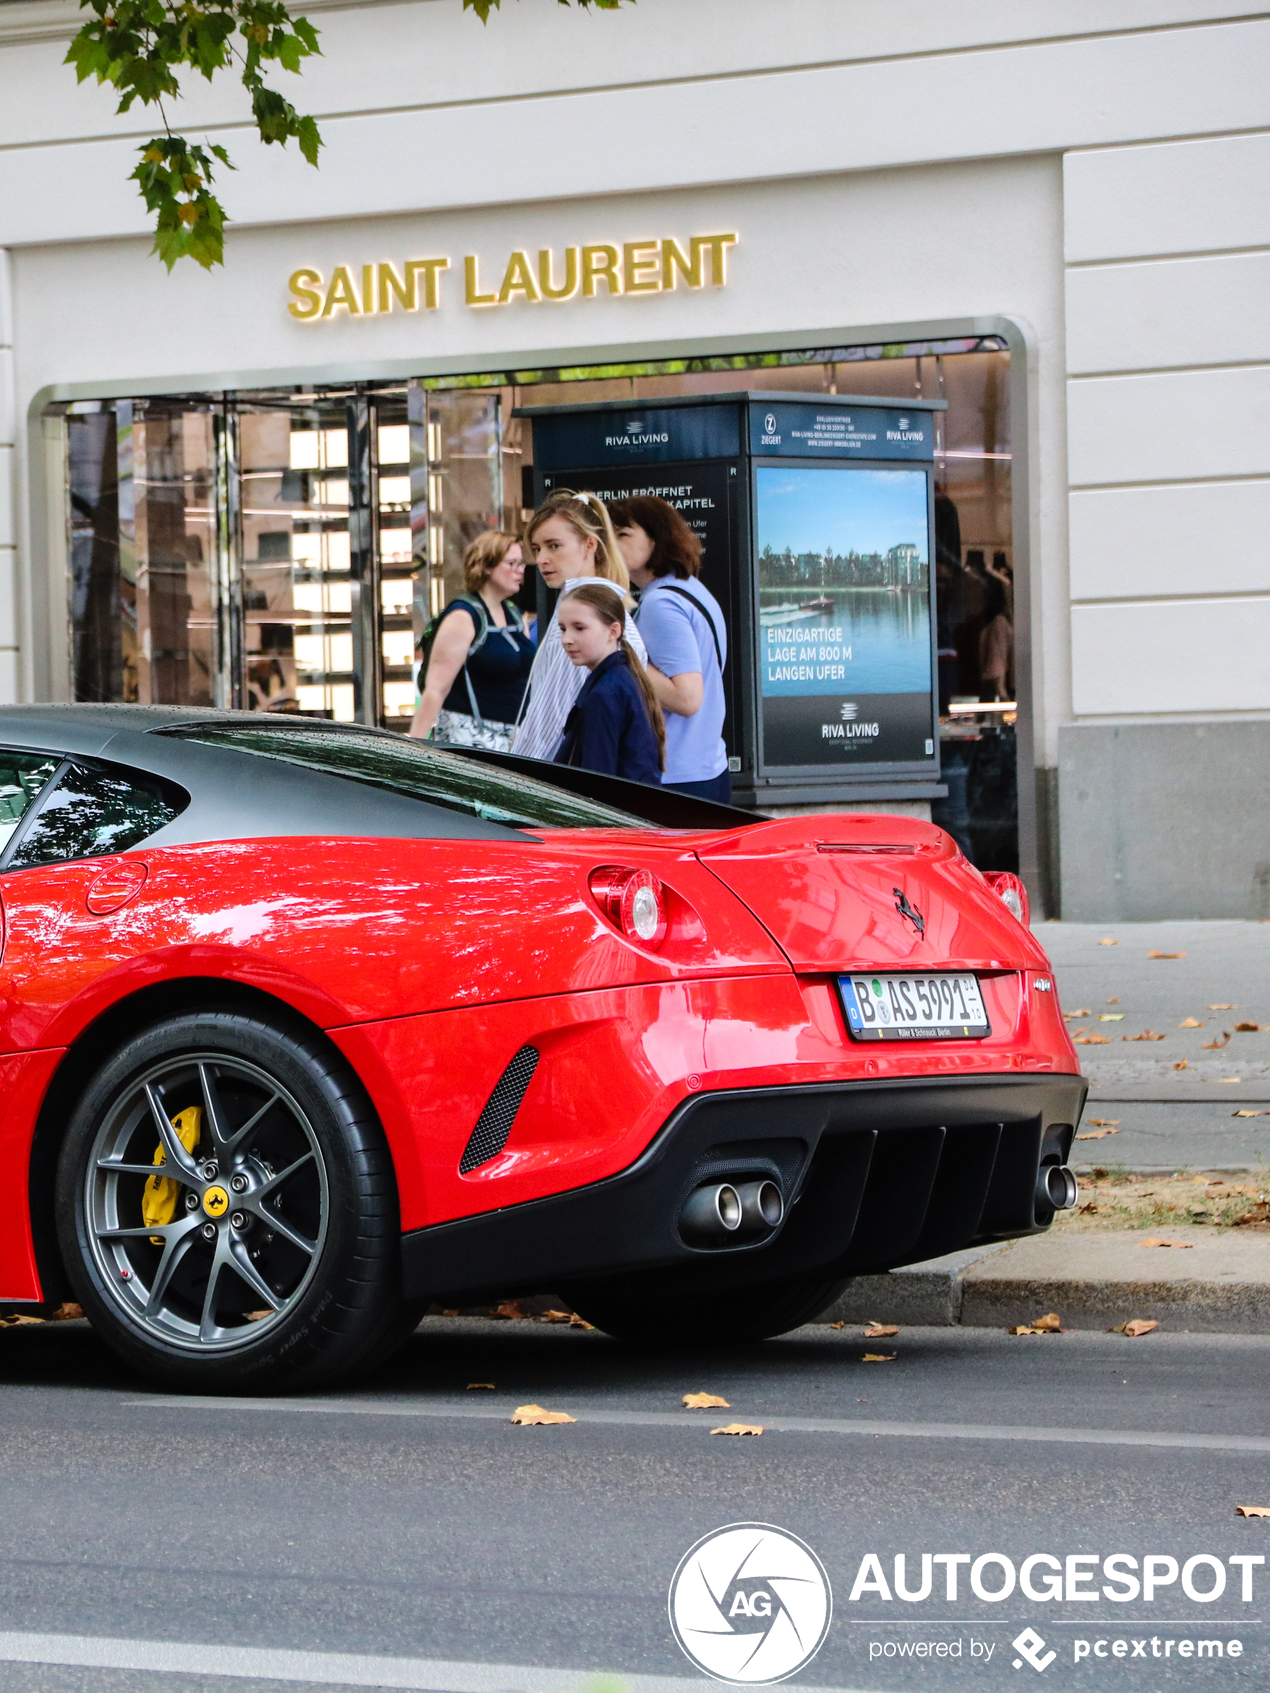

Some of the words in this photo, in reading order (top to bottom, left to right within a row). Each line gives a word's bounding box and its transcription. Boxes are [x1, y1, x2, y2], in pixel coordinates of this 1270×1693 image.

[287, 257, 450, 322] SAINT
[463, 233, 738, 307] LAURENT
[605, 436, 630, 446] RIVA
[632, 433, 669, 445] LIVING
[761, 435, 782, 445] ZIEGERT
[887, 430, 901, 441] RIVA
[903, 431, 924, 442] LIVING
[730, 468, 737, 476] R
[545, 479, 551, 487] R
[632, 486, 693, 498] ERÖFFNET
[667, 498, 715, 510] KAPITEL
[767, 628, 843, 643] EINZIGARTIGE
[768, 647, 797, 662] LAGE
[799, 647, 816, 661] AM
[819, 647, 840, 661] 800
[843, 647, 852, 660] M
[768, 666, 814, 681] LANGEN
[816, 665, 845, 680] UFER
[822, 724, 845, 738] RIVA
[846, 722, 879, 737] LIVING
[850, 1007, 858, 1020] D
[854, 981, 876, 1023] B
[887, 980, 918, 1022] AS
[915, 979, 971, 1021] 5991
